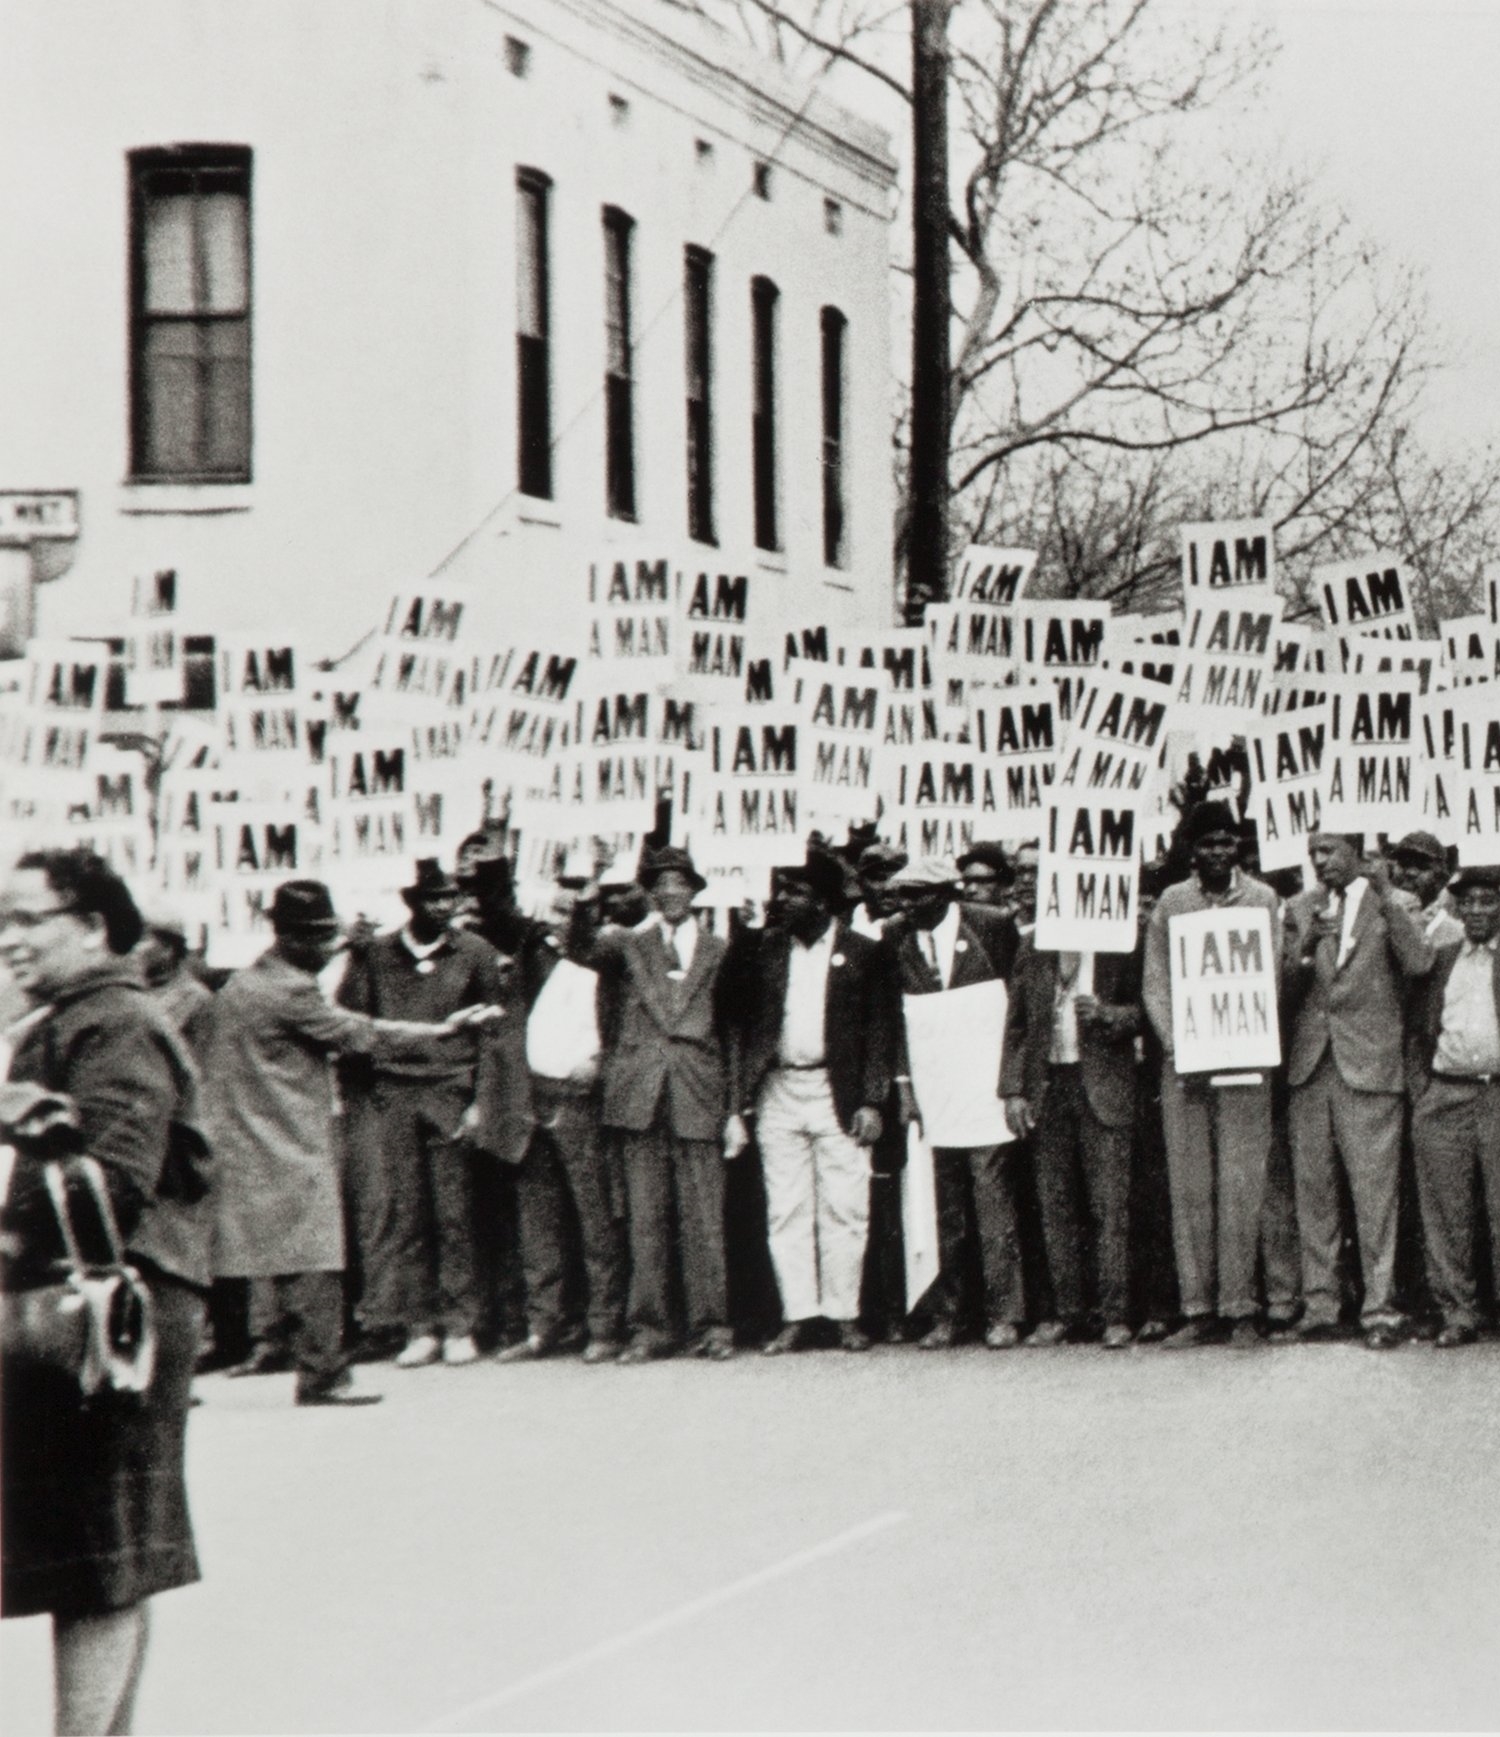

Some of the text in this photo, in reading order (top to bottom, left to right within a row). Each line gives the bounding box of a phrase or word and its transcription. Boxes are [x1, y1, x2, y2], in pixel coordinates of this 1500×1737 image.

[588, 558, 669, 603] I AM
[956, 560, 1024, 604] I AM
[1189, 535, 1268, 587] I AM
[384, 595, 464, 641] I AM
[687, 572, 749, 621] AM
[1323, 567, 1405, 626] I AM
[1489, 580, 1498, 625] I
[588, 616, 669, 659] A MAN
[690, 631, 744, 678] MAN
[946, 613, 1013, 659] A MAN
[1024, 617, 1105, 664] I AM
[1188, 608, 1203, 649] I
[1205, 609, 1273, 656] AM
[47, 663, 97, 709] AM
[221, 650, 231, 693] I
[243, 646, 295, 692] AM
[496, 647, 578, 701] I AM
[1178, 663, 1193, 704] A
[1202, 664, 1262, 710] MAN
[251, 710, 298, 749] MAN
[575, 700, 584, 745] I
[592, 692, 649, 743] AM
[811, 682, 879, 730] AM
[977, 702, 1055, 754] I AM
[1078, 686, 1099, 731] I
[1095, 691, 1167, 748] AM
[1332, 693, 1342, 741] I
[1350, 691, 1412, 742] AM
[505, 709, 556, 758] MAN
[712, 726, 721, 773] I
[732, 724, 798, 773] AM
[1461, 721, 1471, 770] I
[331, 747, 405, 799] I AM
[597, 757, 647, 799] MAN
[816, 740, 872, 789] MAN
[898, 761, 975, 806] I AM
[1060, 746, 1147, 791] A MAN
[1253, 737, 1267, 783] I
[1329, 755, 1411, 803] A MAN
[714, 788, 797, 833] A MAN
[982, 768, 996, 812] A
[1466, 786, 1482, 835] A
[355, 812, 404, 852] MAN
[921, 818, 974, 859] MAN
[1049, 805, 1135, 857] I AM
[1265, 797, 1279, 841] A
[215, 824, 224, 870] I
[237, 823, 297, 871] AM
[1046, 871, 1131, 920] A MAN
[1179, 929, 1264, 979] I AM
[1185, 991, 1268, 1039] A MAN
